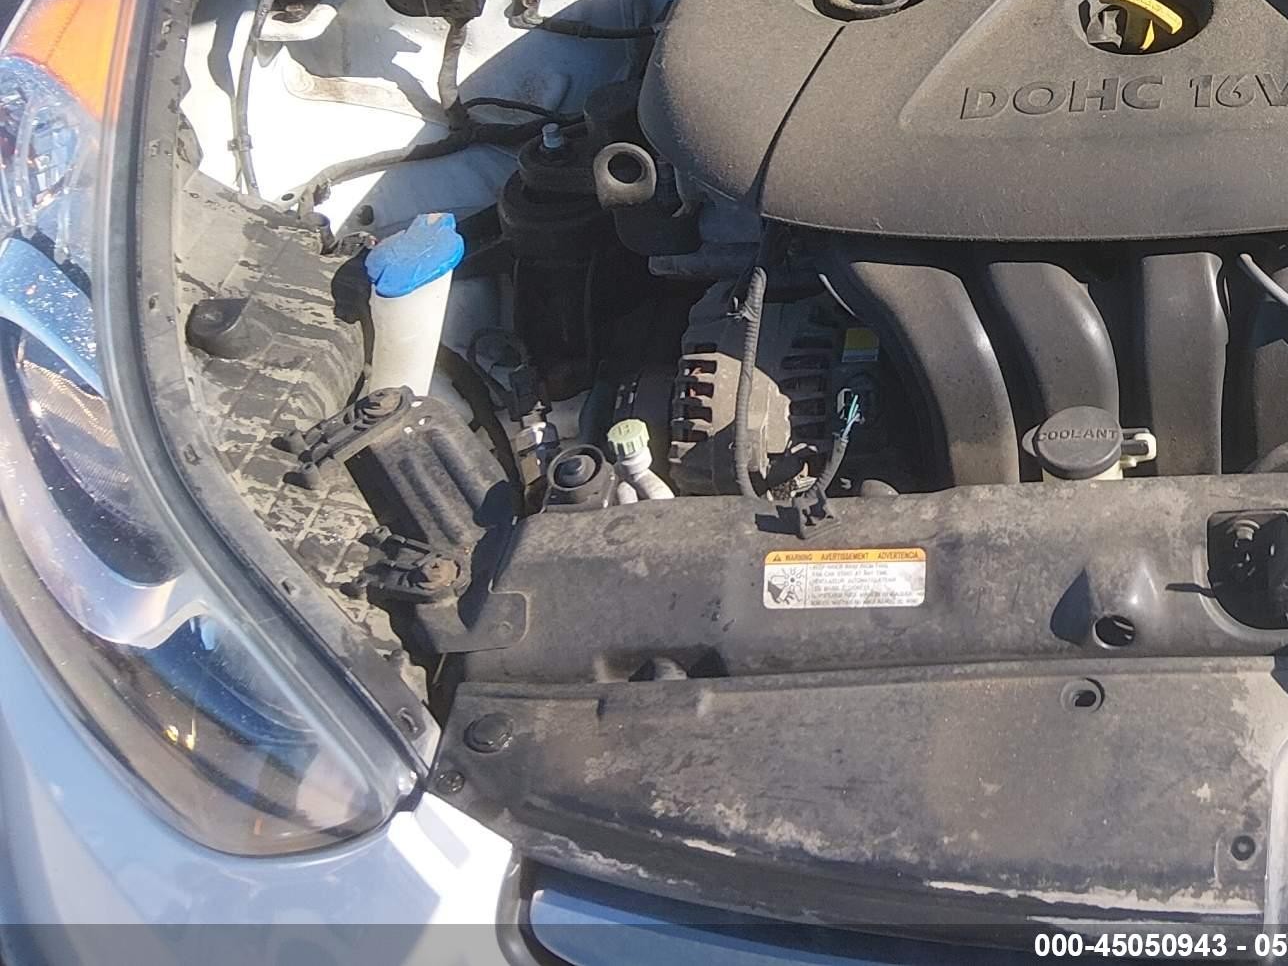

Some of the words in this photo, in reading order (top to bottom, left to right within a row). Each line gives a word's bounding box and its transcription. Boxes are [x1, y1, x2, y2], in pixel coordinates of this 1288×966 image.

[960, 74, 1164, 120] DOHC
[1036, 428, 1119, 442] COOLANT
[785, 553, 812, 561] WARNING
[821, 552, 869, 560] AVERTISSEMENT
[877, 551, 919, 559] ADVERTENCIA
